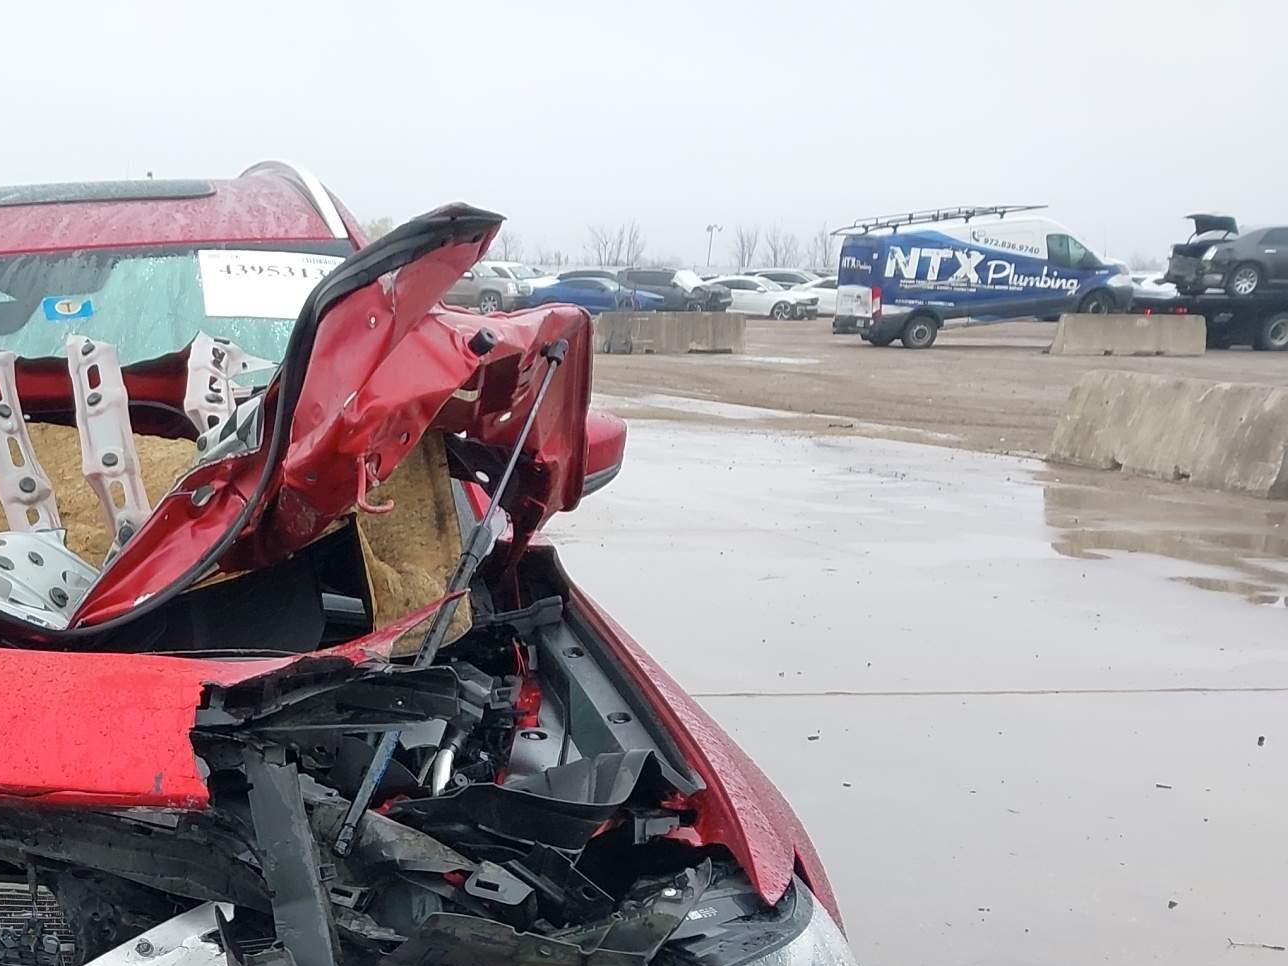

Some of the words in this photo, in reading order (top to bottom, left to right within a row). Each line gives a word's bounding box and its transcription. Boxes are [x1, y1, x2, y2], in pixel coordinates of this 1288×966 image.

[841, 255, 856, 270] NTX
[884, 246, 985, 284] NTX
[987, 260, 1080, 295] Plumbing
[218, 263, 329, 280] 4395313
